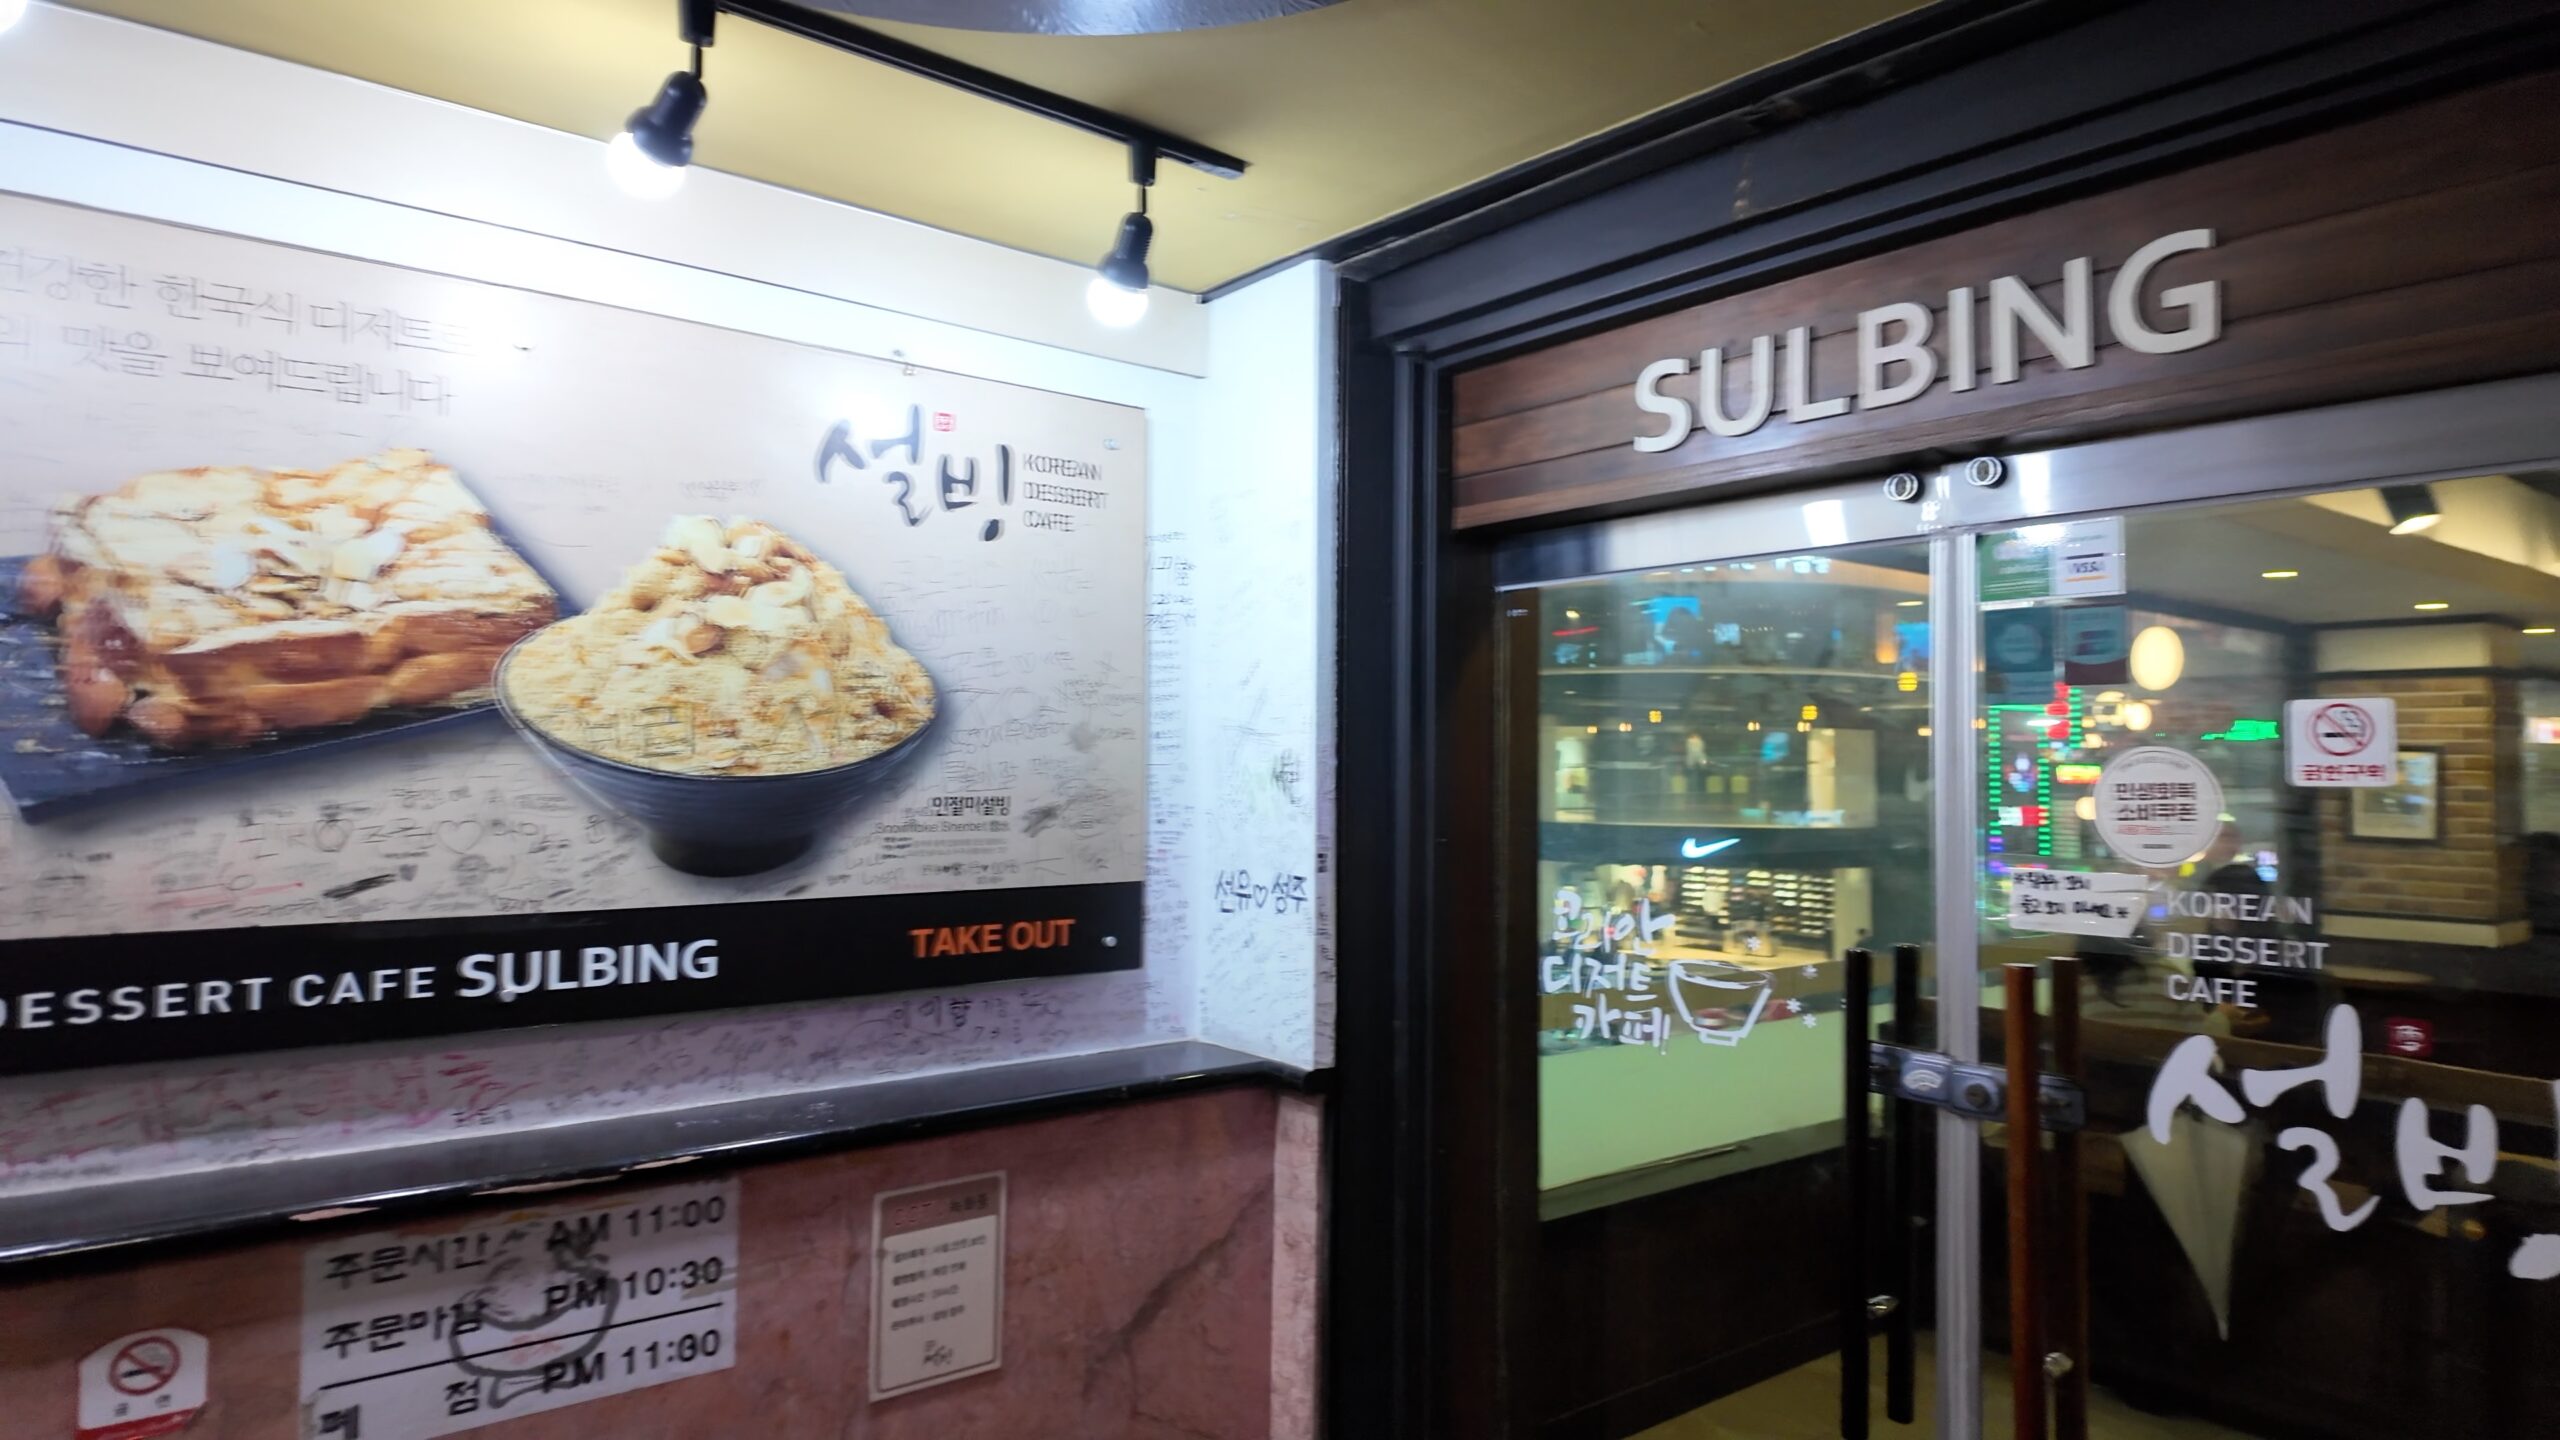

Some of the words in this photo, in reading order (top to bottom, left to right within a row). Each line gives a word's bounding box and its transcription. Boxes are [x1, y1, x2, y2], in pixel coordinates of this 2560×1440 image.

[152, 273, 298, 335] 한국식
[1633, 228, 2223, 453] SULBING
[814, 403, 1015, 543] 설빙
[1023, 453, 1102, 480] KOREAN
[1023, 481, 1109, 509] DESSERT
[1023, 509, 1076, 532] CAFE
[2166, 889, 2314, 926] KOREAN
[908, 923, 1003, 959] TAKE
[1011, 918, 1076, 951] OUT
[2166, 931, 2330, 970] DESSERT
[0, 976, 272, 1030] ESSERT
[288, 966, 437, 1008] CAFE
[456, 938, 721, 998] SULBING
[1541, 952, 1657, 1001] 디저트
[2166, 974, 2258, 1008] CAFE
[1571, 994, 1672, 1055] 카페
[324, 1232, 492, 1290] 주문시간
[624, 1195, 726, 1238] 11:00
[543, 1275, 612, 1317] PM
[623, 1256, 724, 1301] 10:30
[445, 1375, 481, 1416] 점
[542, 1352, 607, 1394] PM
